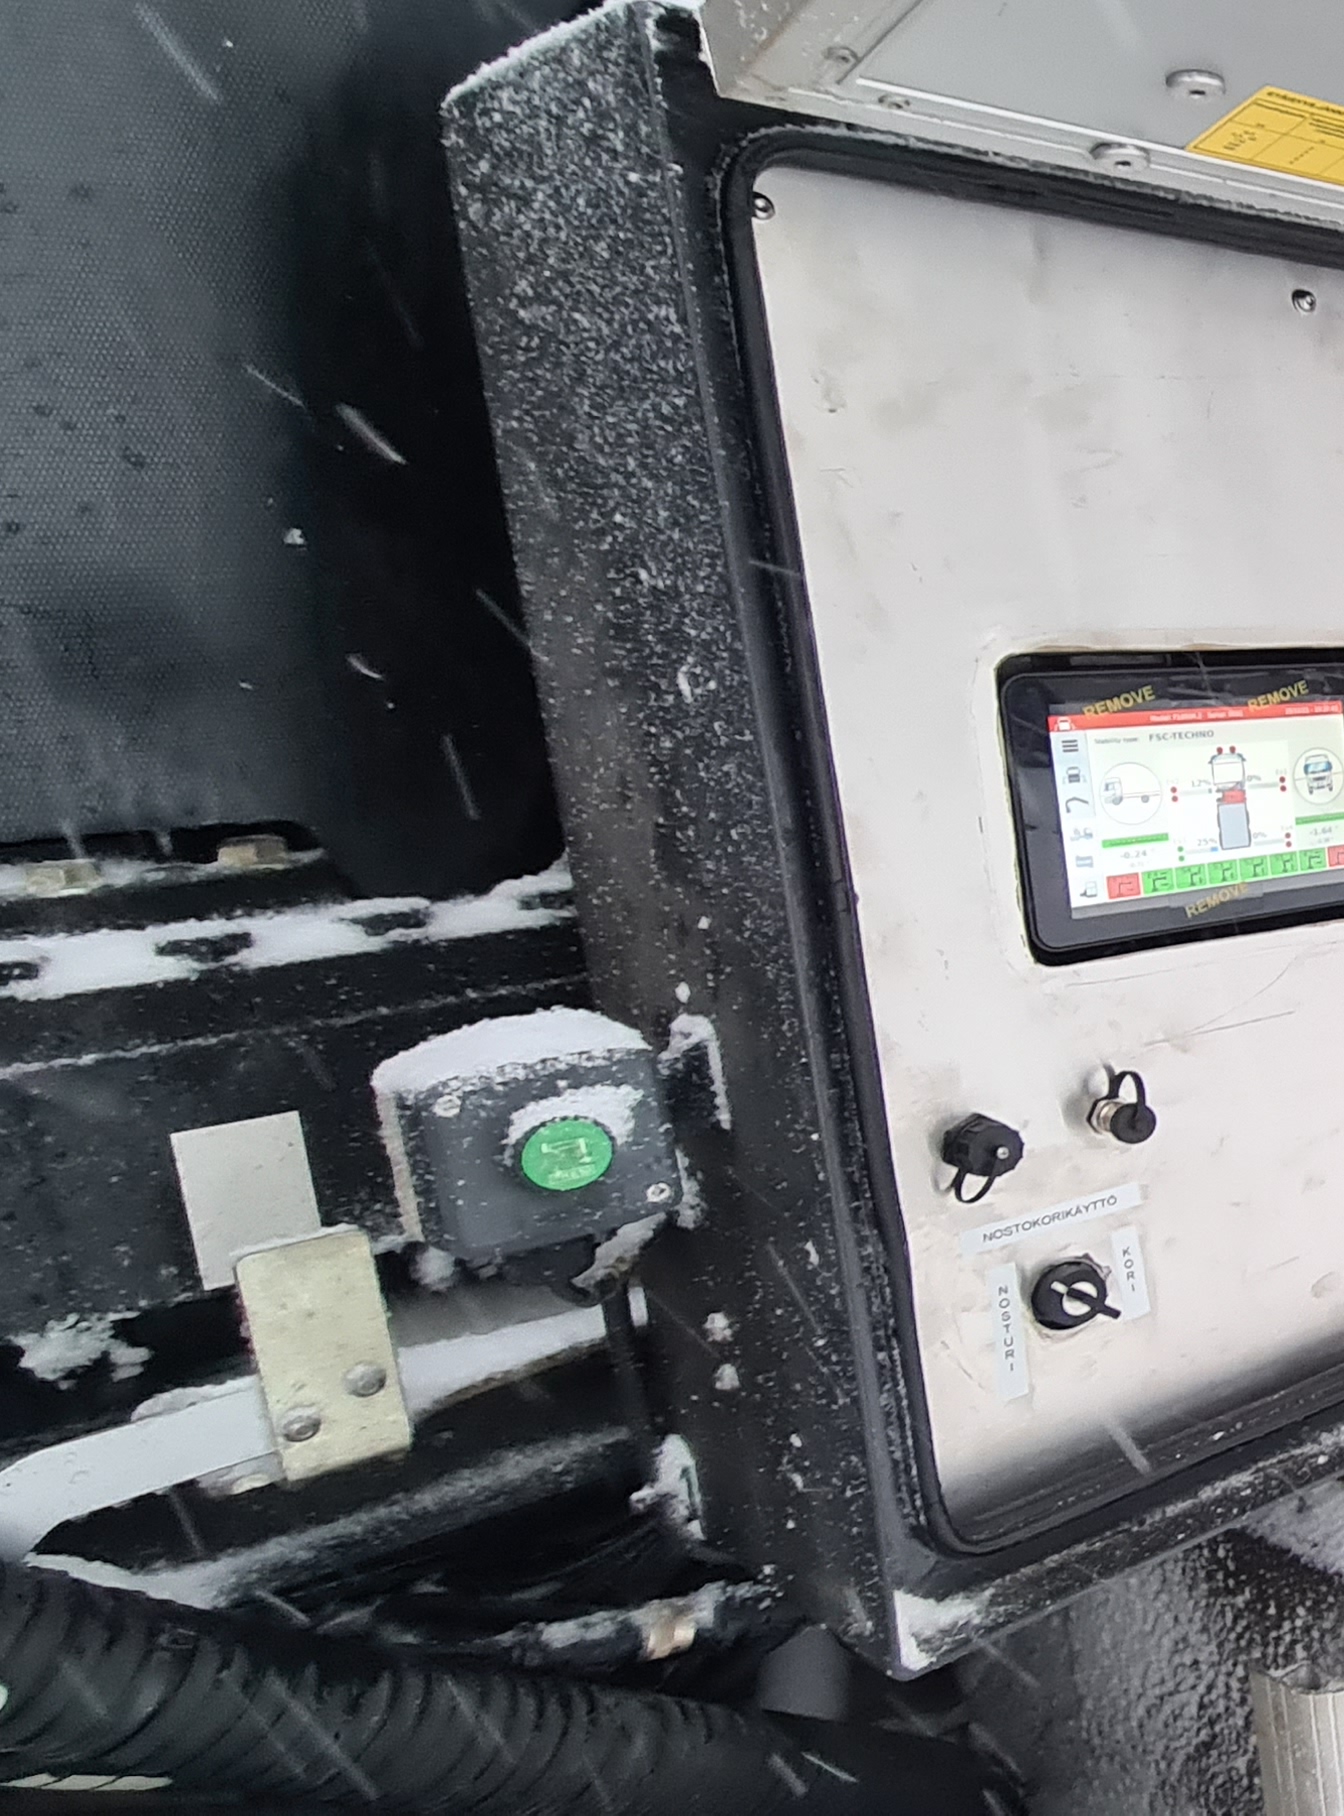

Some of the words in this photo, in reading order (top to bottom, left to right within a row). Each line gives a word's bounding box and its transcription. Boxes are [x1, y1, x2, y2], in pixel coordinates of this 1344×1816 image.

[1082, 685, 1156, 719] REMOVE
[1247, 680, 1310, 712] REMOVE
[1148, 729, 1215, 742] FSC-TECHNO
[1184, 882, 1249, 918] REMOVE
[1121, 1246, 1136, 1292] KORI
[997, 1285, 1015, 1371] NOSTURI
